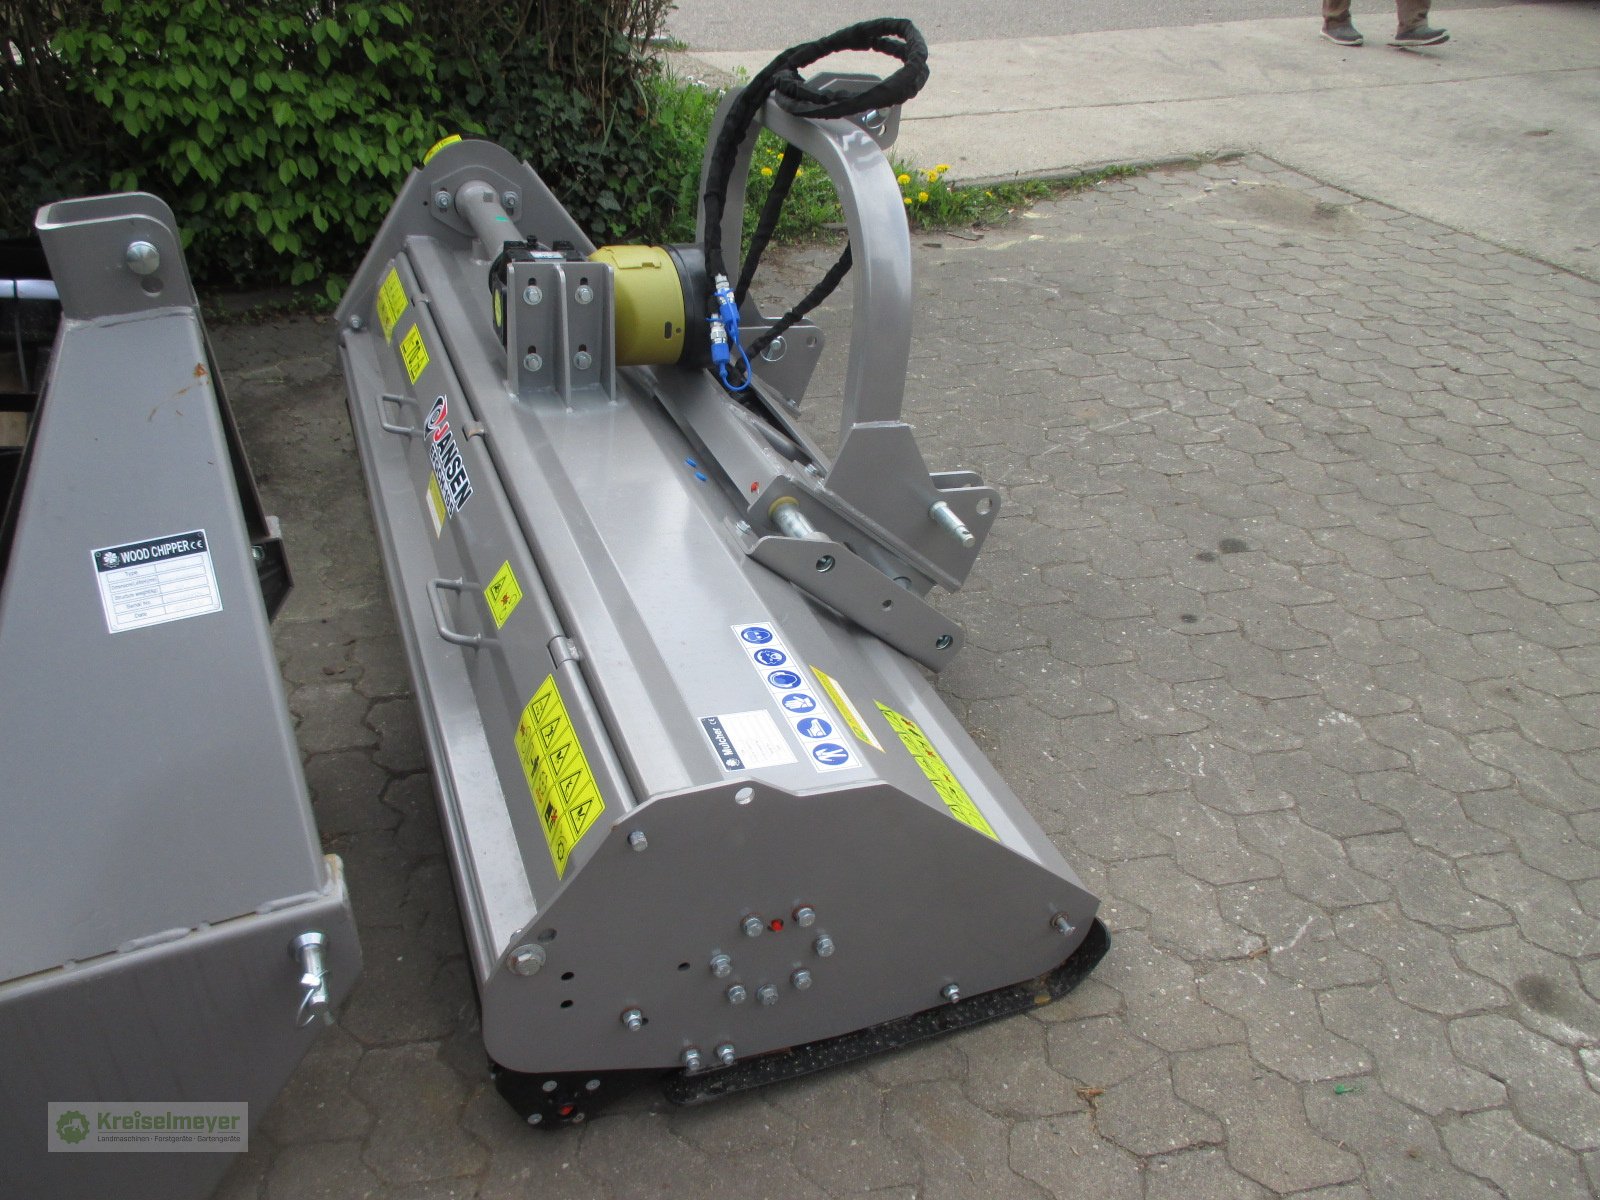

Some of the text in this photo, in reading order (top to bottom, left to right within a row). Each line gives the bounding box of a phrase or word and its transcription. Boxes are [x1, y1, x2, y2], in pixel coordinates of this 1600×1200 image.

[433, 421, 473, 512] JANSEN
[120, 548, 150, 564] WOOD
[151, 540, 191, 557] CHIPPER
[712, 727, 734, 756] Mulcher
